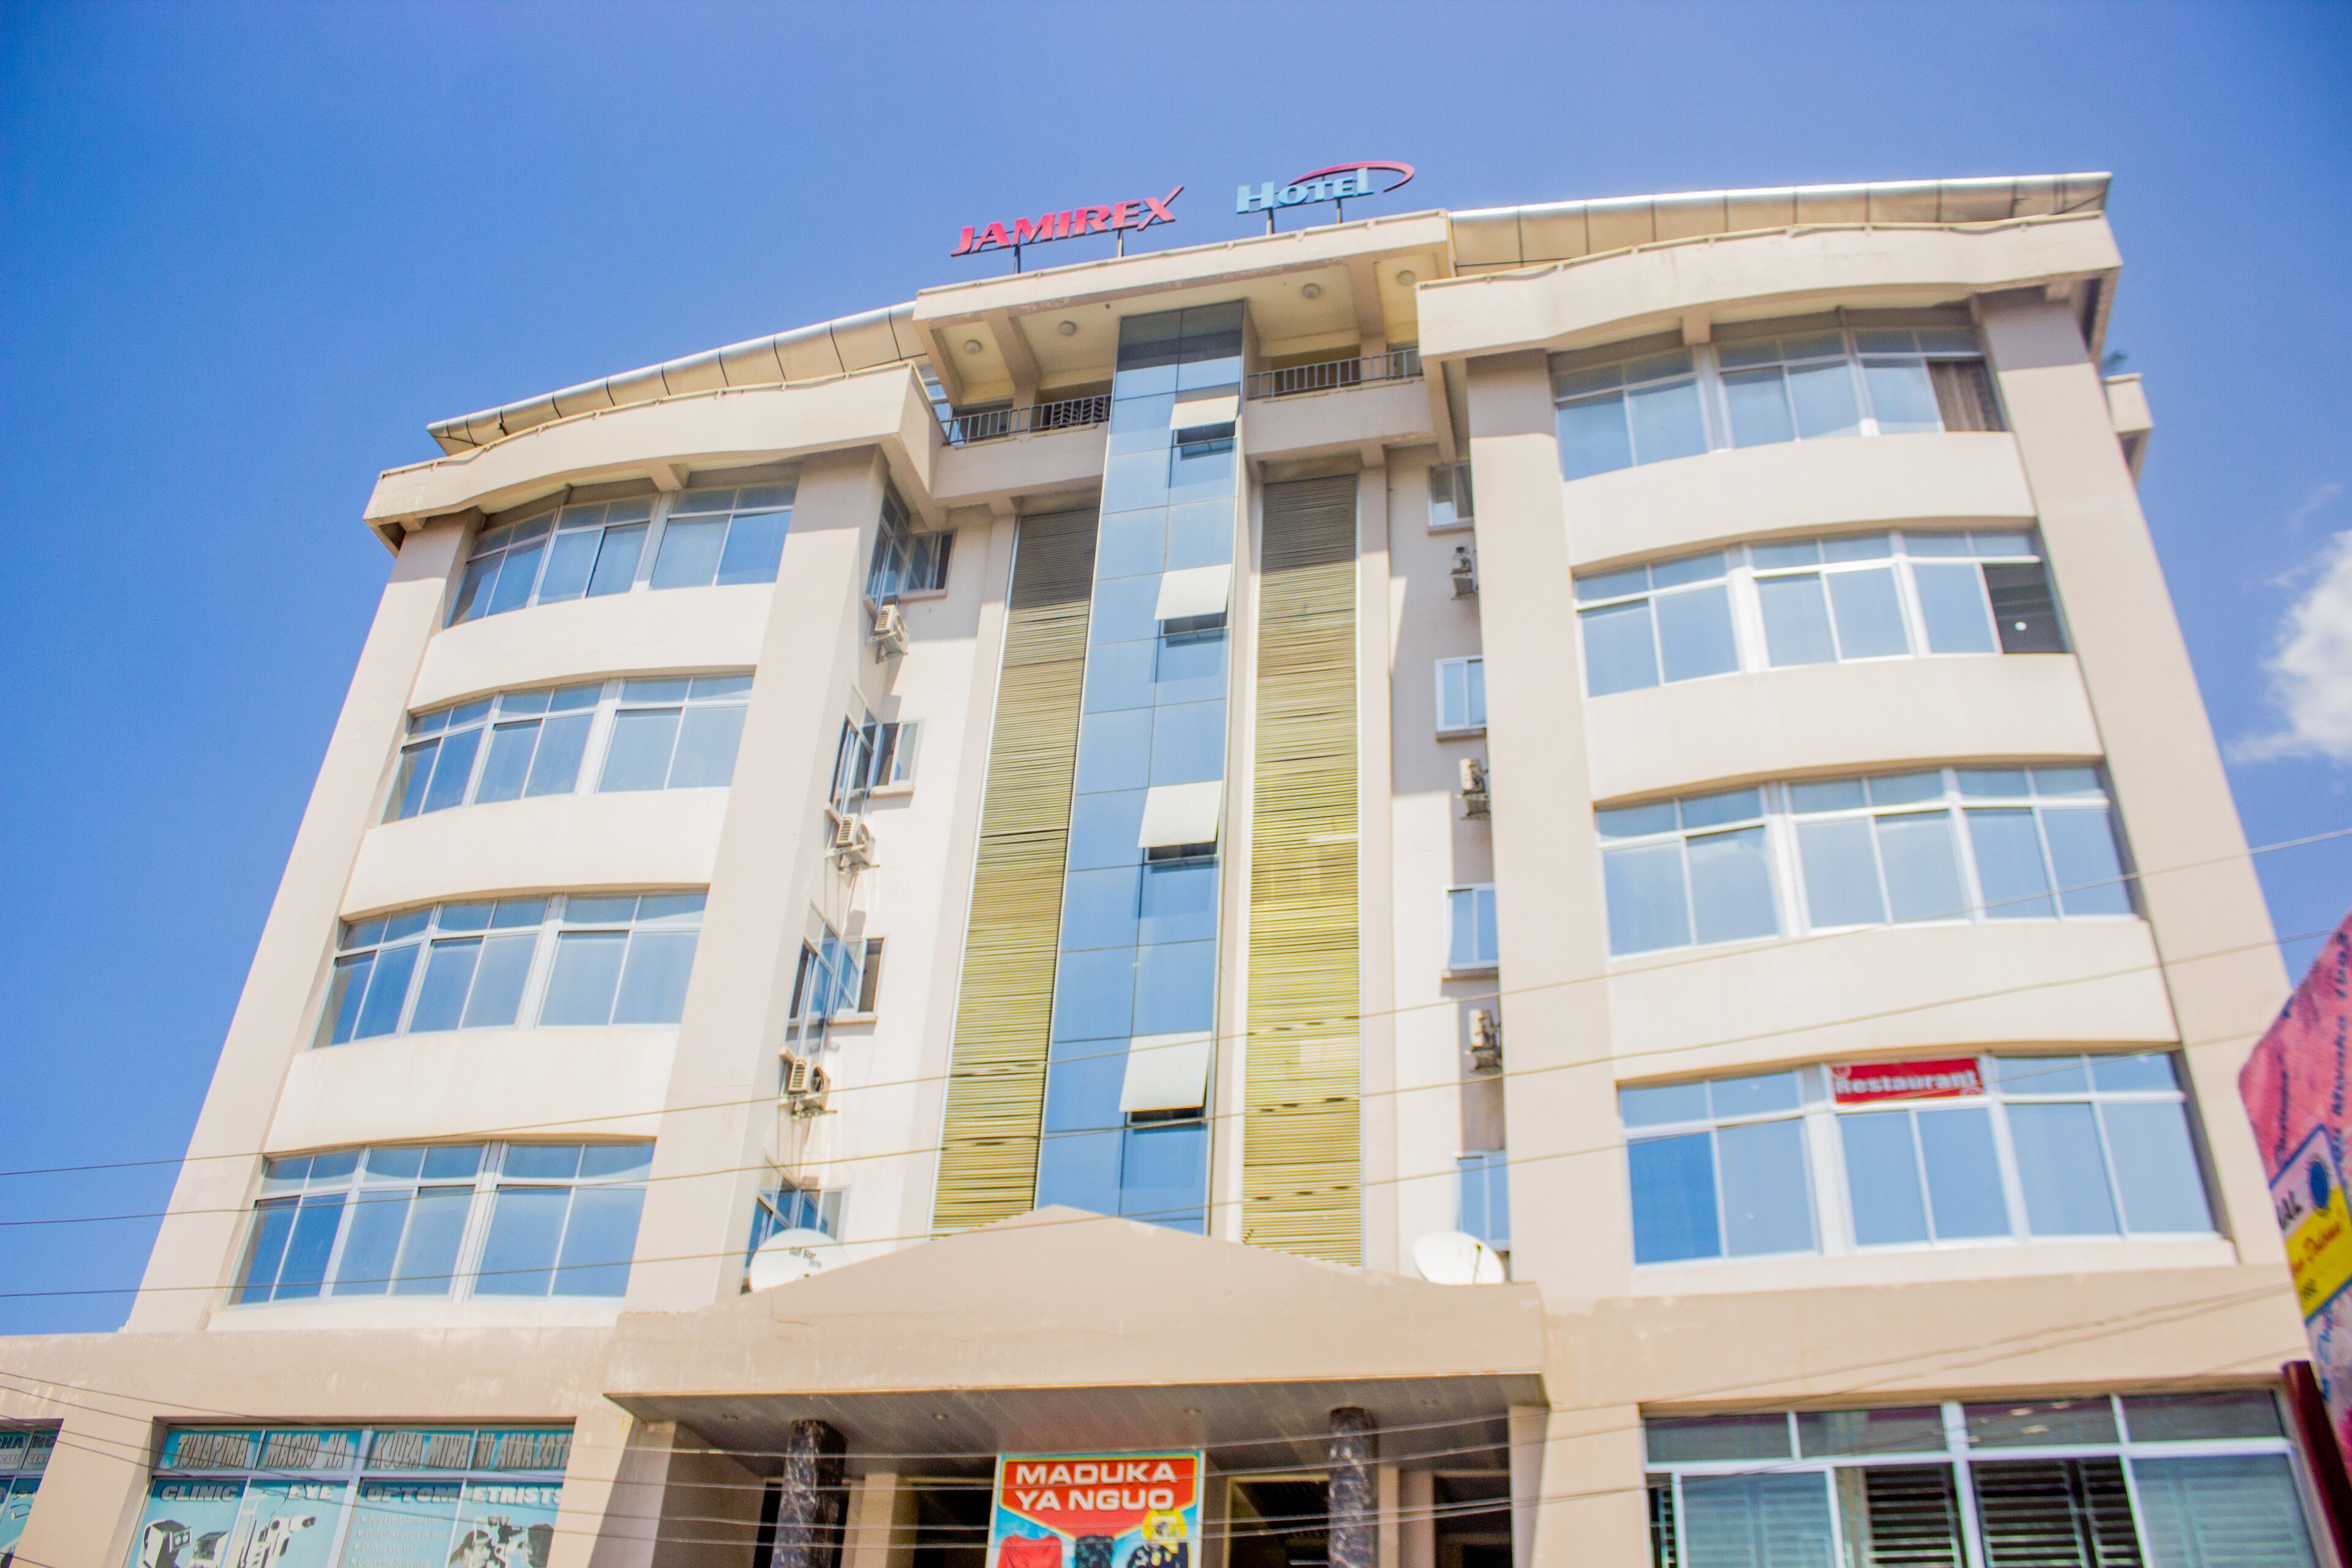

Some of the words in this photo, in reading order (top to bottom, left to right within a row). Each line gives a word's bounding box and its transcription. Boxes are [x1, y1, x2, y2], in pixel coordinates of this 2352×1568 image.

[951, 185, 1184, 257] JAMIREX
[1835, 1071, 1977, 1095] Restaurant
[173, 1434, 251, 1468] TUNAPIMA
[263, 1434, 321, 1468] MACHO
[323, 1434, 349, 1469] NA
[372, 1434, 424, 1468] KUUZA
[1016, 1463, 1177, 1485] MADUKA
[160, 1485, 238, 1502] CLINIC
[288, 1484, 336, 1500] EYE
[1016, 1490, 1061, 1511] YA
[1068, 1488, 1174, 1511] NGUO
